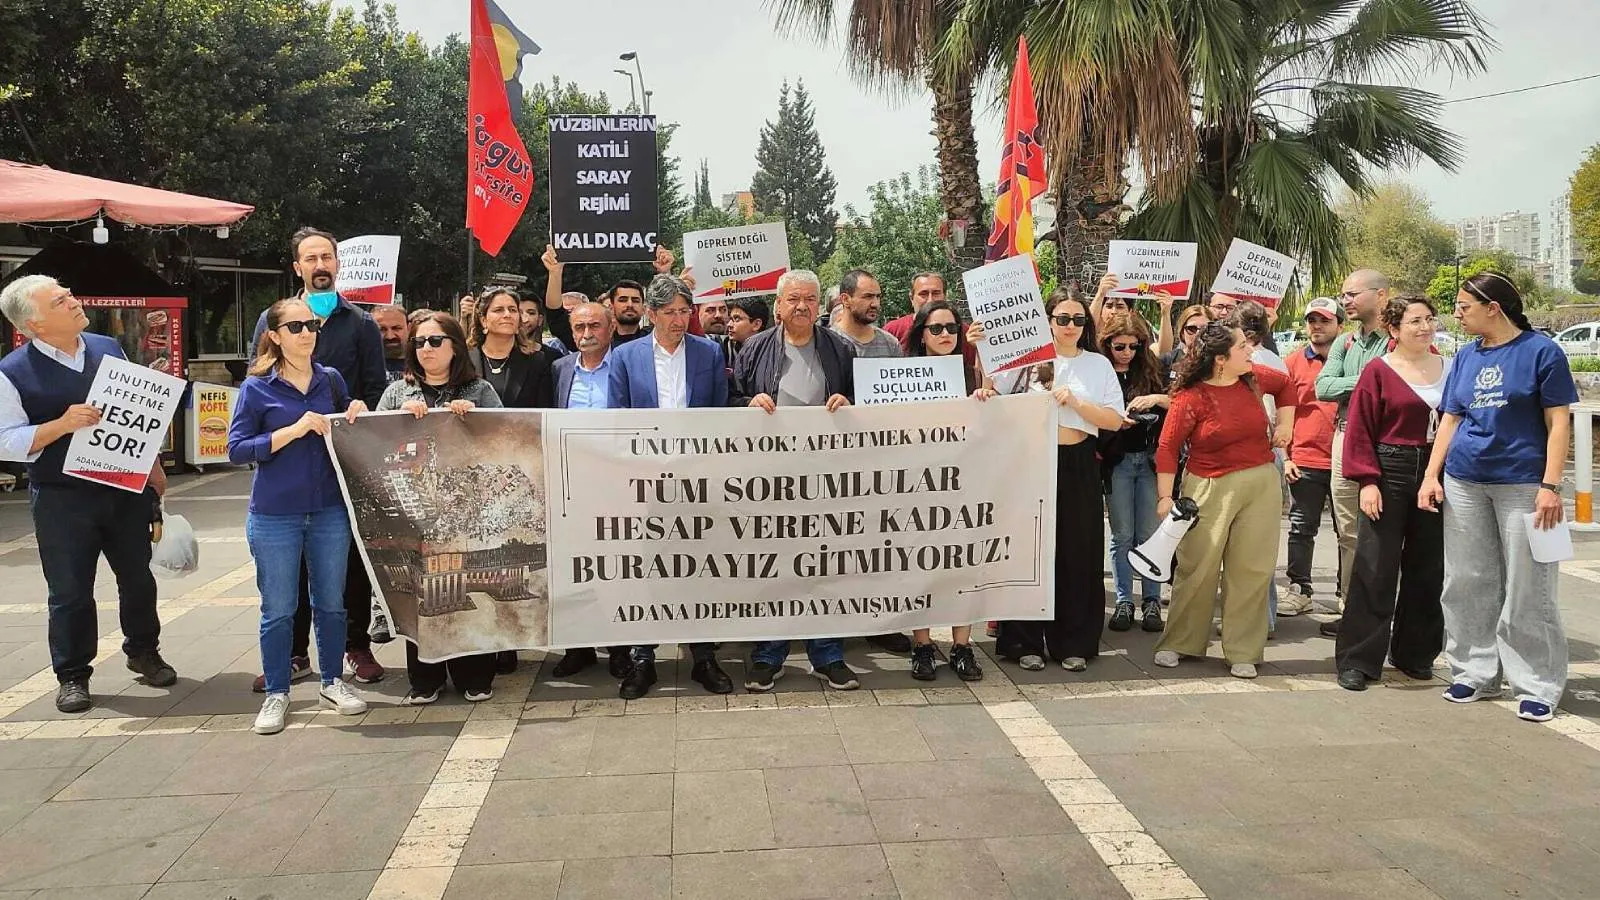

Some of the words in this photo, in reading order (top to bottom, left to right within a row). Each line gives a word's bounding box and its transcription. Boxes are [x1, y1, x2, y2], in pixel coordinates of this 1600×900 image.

[548, 115, 656, 132] YÜZBİNLERİN
[577, 140, 629, 158] KATİLİ
[576, 170, 632, 185] SARAY
[579, 193, 630, 215] REJİMİ
[554, 232, 657, 252] KALDIRAÇ
[697, 236, 737, 249] DEPREM
[739, 232, 768, 245] DEĞİL
[342, 258, 380, 268] LULARI
[716, 250, 752, 262] SİSTEM
[1247, 251, 1282, 270] DEPREM
[338, 271, 388, 282] ILANSIN!
[712, 263, 761, 278] ÖLDÜRDÜ
[1124, 272, 1151, 280] SARAY
[93, 297, 146, 307] LEZZETLERİ
[975, 292, 1034, 316] HESABINI
[984, 308, 1041, 331] ORMAYA
[989, 326, 1039, 346] GELDİK!
[991, 351, 1015, 363] ADANA
[880, 367, 934, 379] DEPREM
[108, 369, 171, 398] UNUTMA
[873, 381, 947, 396] SUÇLULARI
[103, 385, 165, 412] AFFETME
[200, 402, 228, 413] KÖFTE
[88, 428, 146, 459] SOR!
[631, 436, 739, 456] UNUTMAK
[744, 435, 797, 453] YOK!
[802, 428, 912, 452] AFFETMEK
[918, 425, 967, 445] YOK!
[75, 456, 102, 469] ADANA
[103, 463, 134, 476] DEPREM
[629, 472, 708, 504] TÜM
[723, 466, 962, 504] SORUMLULAR
[593, 515, 714, 541] HESAP
[729, 510, 865, 539] VERENE
[879, 502, 995, 533] KADAR
[572, 552, 779, 584] BURADAYIZ
[793, 536, 1011, 578] GİTMİYORUZ!
[613, 603, 690, 623] ADANA
[695, 600, 785, 620] DEPREM
[789, 593, 933, 618] DAYANIŞMASI
